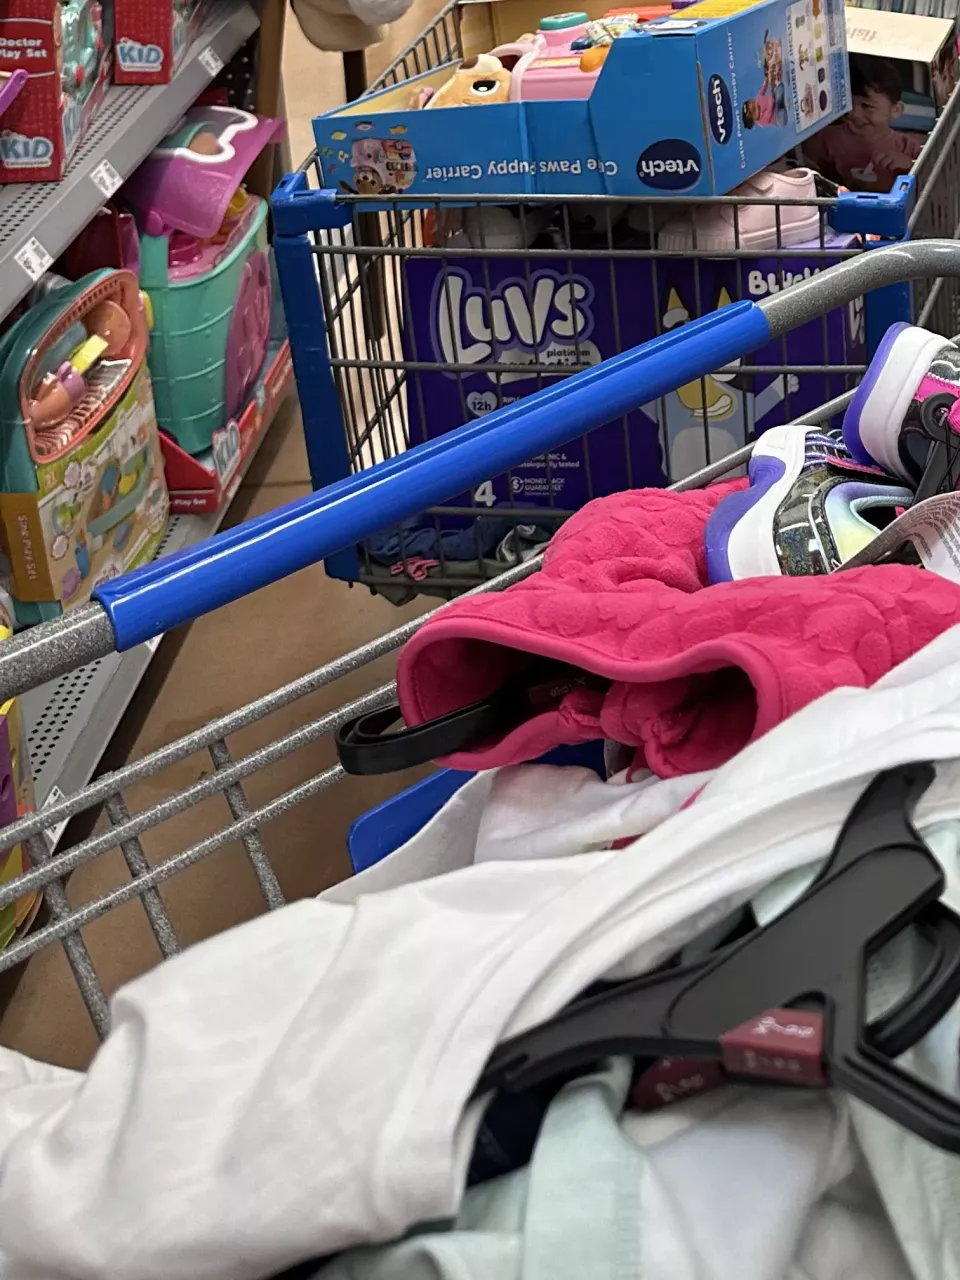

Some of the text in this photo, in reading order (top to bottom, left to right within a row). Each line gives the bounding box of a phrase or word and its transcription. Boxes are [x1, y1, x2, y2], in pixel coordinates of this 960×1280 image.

[0, 38, 43, 47] Doctor
[26, 48, 48, 58] Set
[119, 45, 162, 64] KID
[712, 78, 725, 143] vtech
[1, 138, 52, 159] KID
[426, 165, 483, 180] Carrier
[539, 160, 583, 175] Paws
[641, 158, 700, 176] vtech
[547, 348, 591, 359] platinm
[471, 401, 492, 412] 12h
[474, 480, 497, 507] 4
